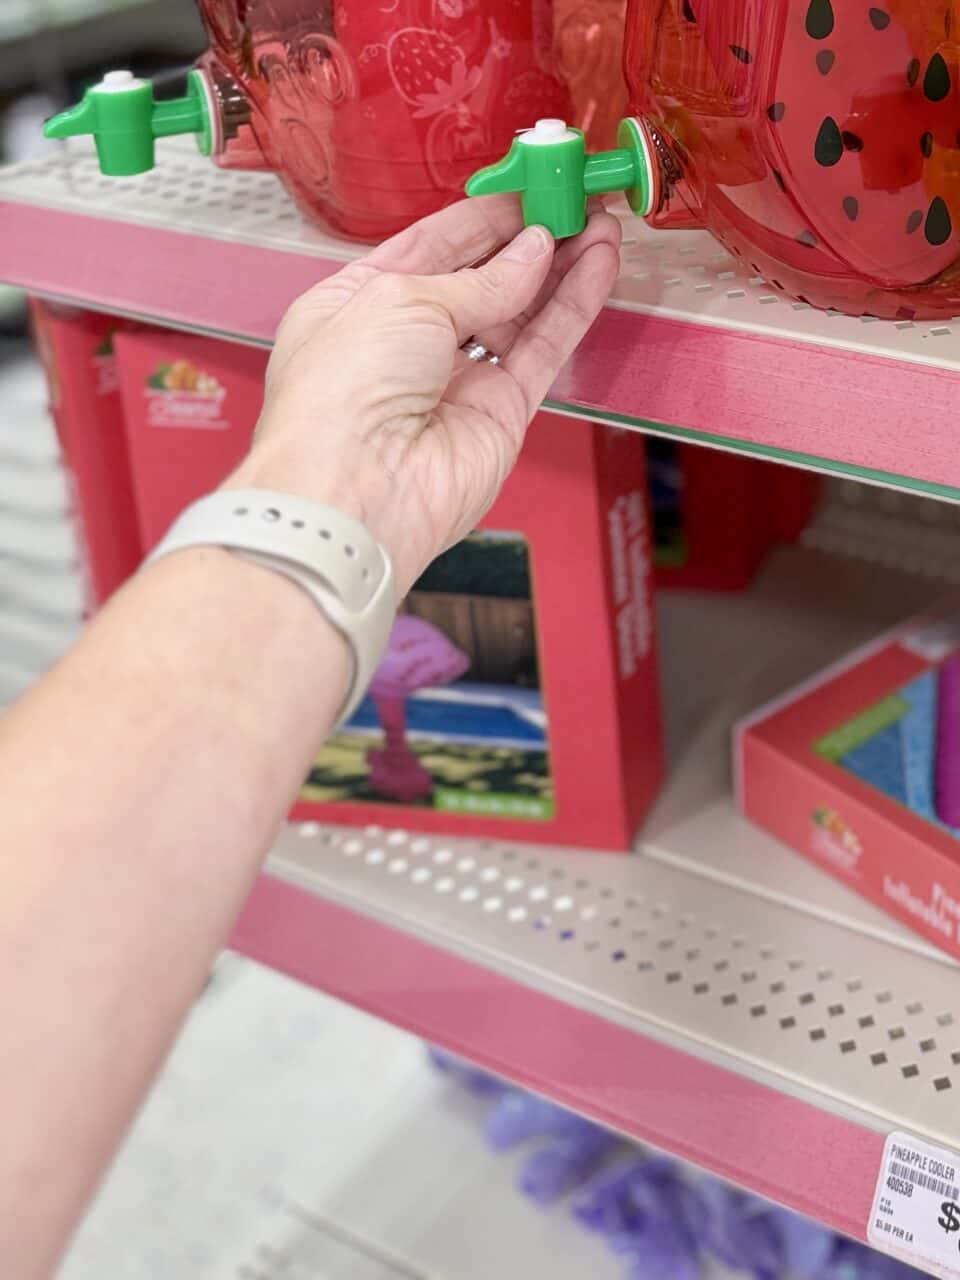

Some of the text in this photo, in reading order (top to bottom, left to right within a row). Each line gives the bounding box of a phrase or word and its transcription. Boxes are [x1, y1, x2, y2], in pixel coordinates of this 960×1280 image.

[890, 1143, 956, 1182] PINEAPPLE COOLER
[892, 1225, 905, 1241] PER
